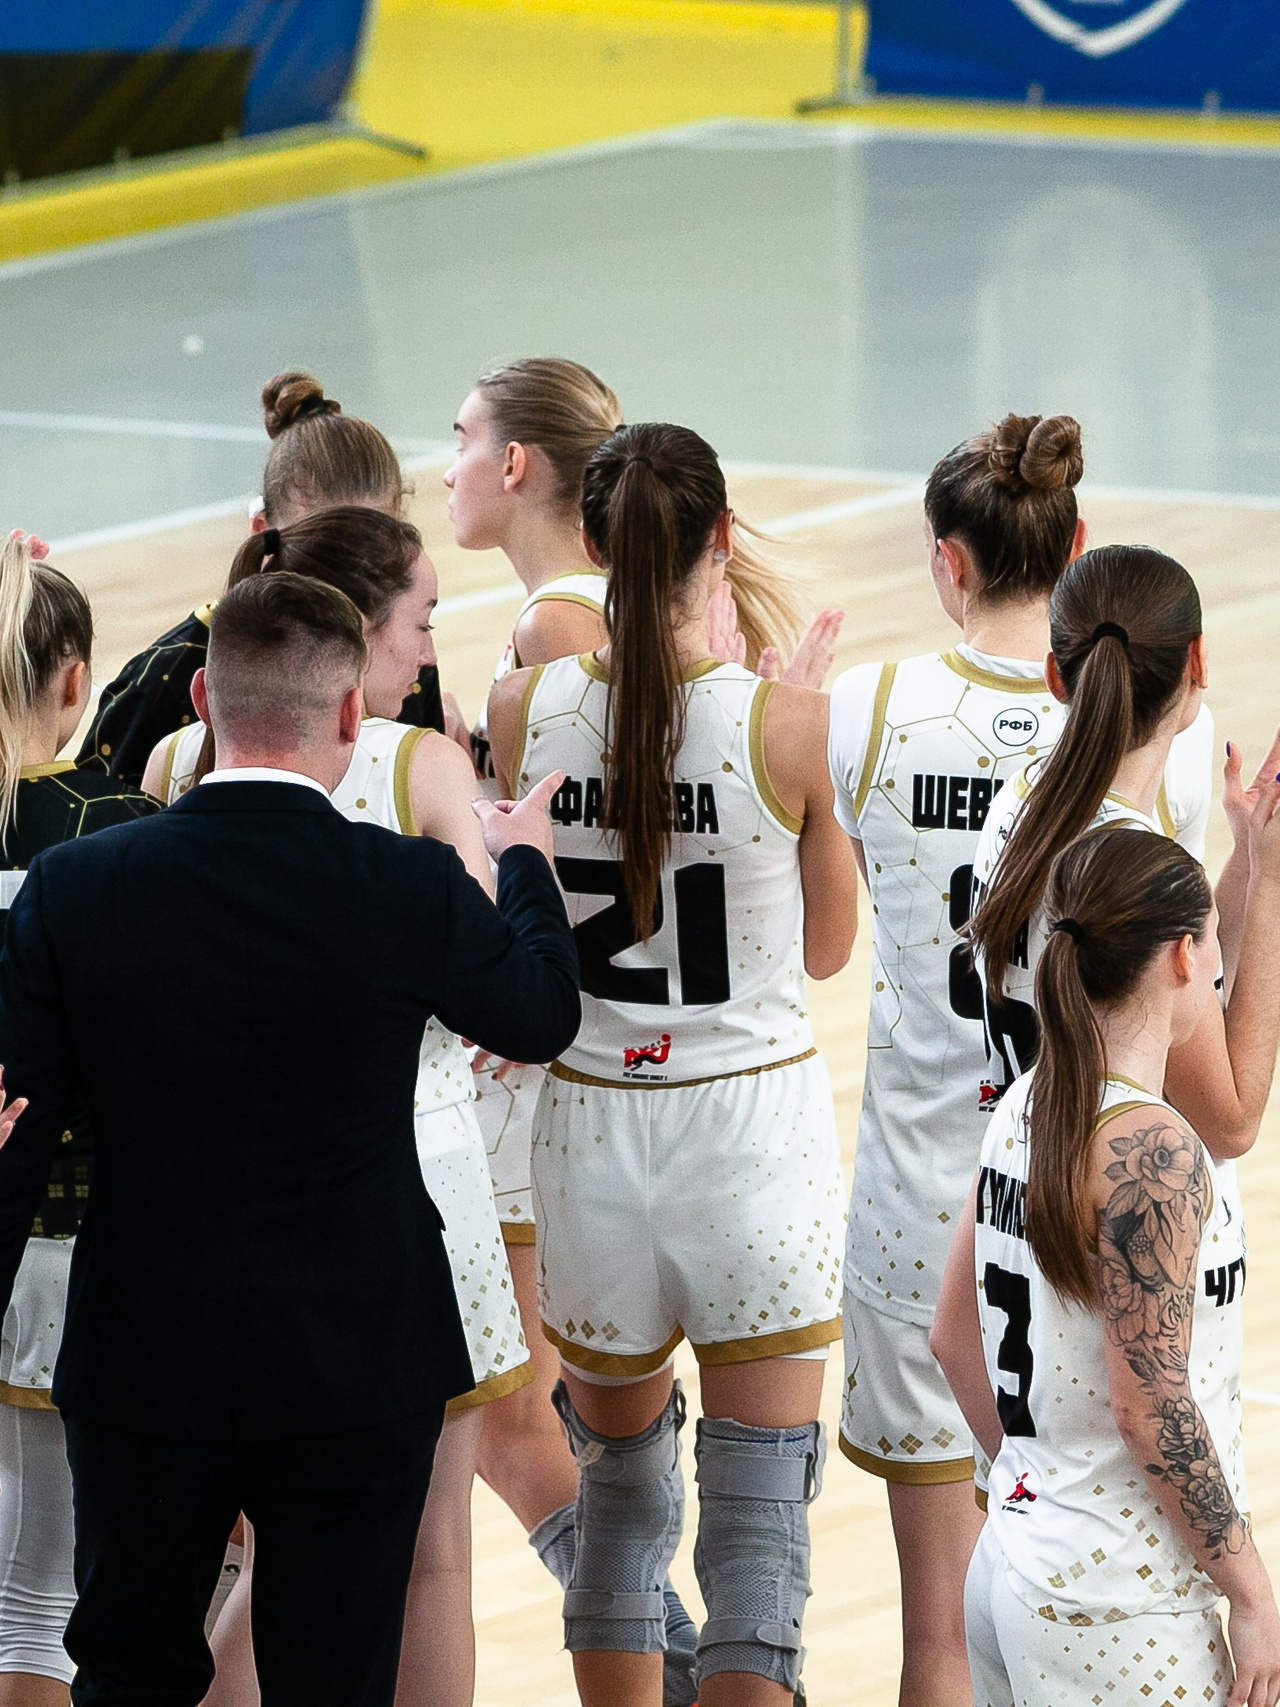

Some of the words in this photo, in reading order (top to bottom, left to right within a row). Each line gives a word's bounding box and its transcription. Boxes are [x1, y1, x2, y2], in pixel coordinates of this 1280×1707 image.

[999, 719, 1033, 731] РФБ
[912, 773, 1004, 831] ШЕВ
[554, 856, 730, 1006] 21
[984, 1261, 1037, 1437] 3
